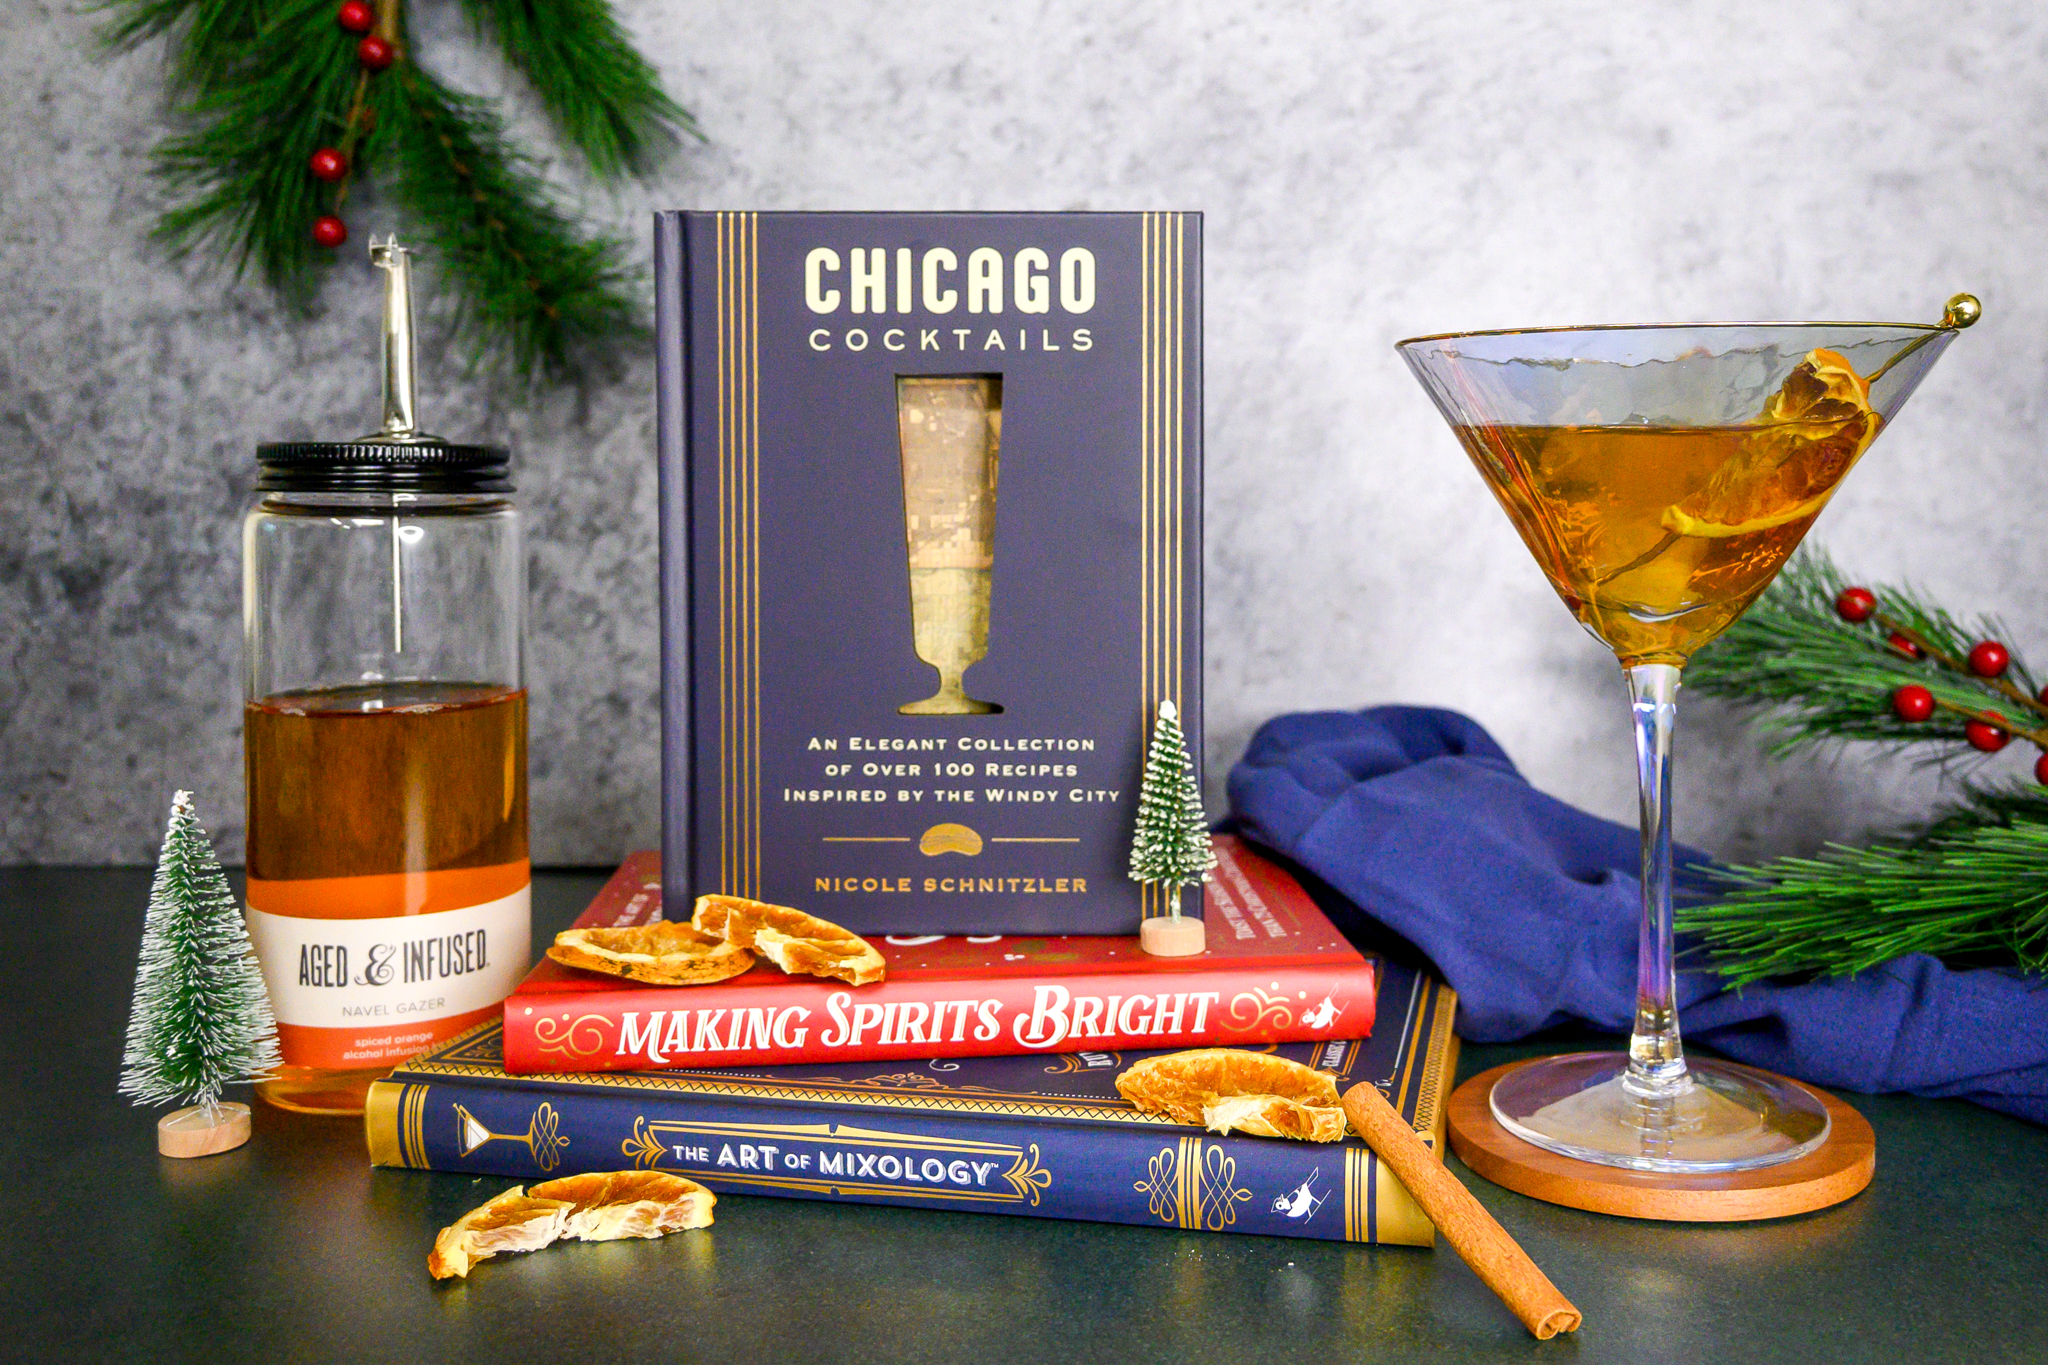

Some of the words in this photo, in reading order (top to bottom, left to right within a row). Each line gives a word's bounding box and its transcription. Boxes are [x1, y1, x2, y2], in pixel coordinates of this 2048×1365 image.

[805, 246, 1096, 315] CHICAGO
[808, 328, 1093, 352] COCKTAILS
[808, 737, 838, 751] AN
[849, 737, 948, 751] ELEGANT
[957, 737, 1095, 752] COLLECTION
[825, 764, 852, 777] OF
[862, 762, 922, 777] OVER
[934, 762, 975, 777] 100
[985, 762, 1078, 777] RECIPES
[784, 788, 887, 802] INSPIRED
[897, 789, 924, 802] BY
[934, 789, 975, 803] THE
[985, 788, 1059, 803] WINDY
[1068, 788, 1120, 803] CITY
[815, 877, 912, 893] NICOLE
[923, 877, 1088, 894] SCHNITZLER
[299, 944, 348, 988] AGED
[354, 943, 397, 986] &
[403, 929, 488, 984] INFUSED
[342, 1005, 390, 1017] NAVEL
[396, 997, 446, 1014] GAZER
[615, 1005, 812, 1064] MAKING
[820, 991, 1004, 1047] SPIRITS
[1012, 985, 1219, 1049] BRIGHT
[354, 1035, 392, 1048] spiced
[394, 1031, 434, 1046] orange
[343, 1048, 383, 1060] alcohol
[386, 1043, 430, 1057] infusion
[672, 1144, 710, 1163] THE
[716, 1143, 780, 1172] ART
[784, 1152, 812, 1170] OF
